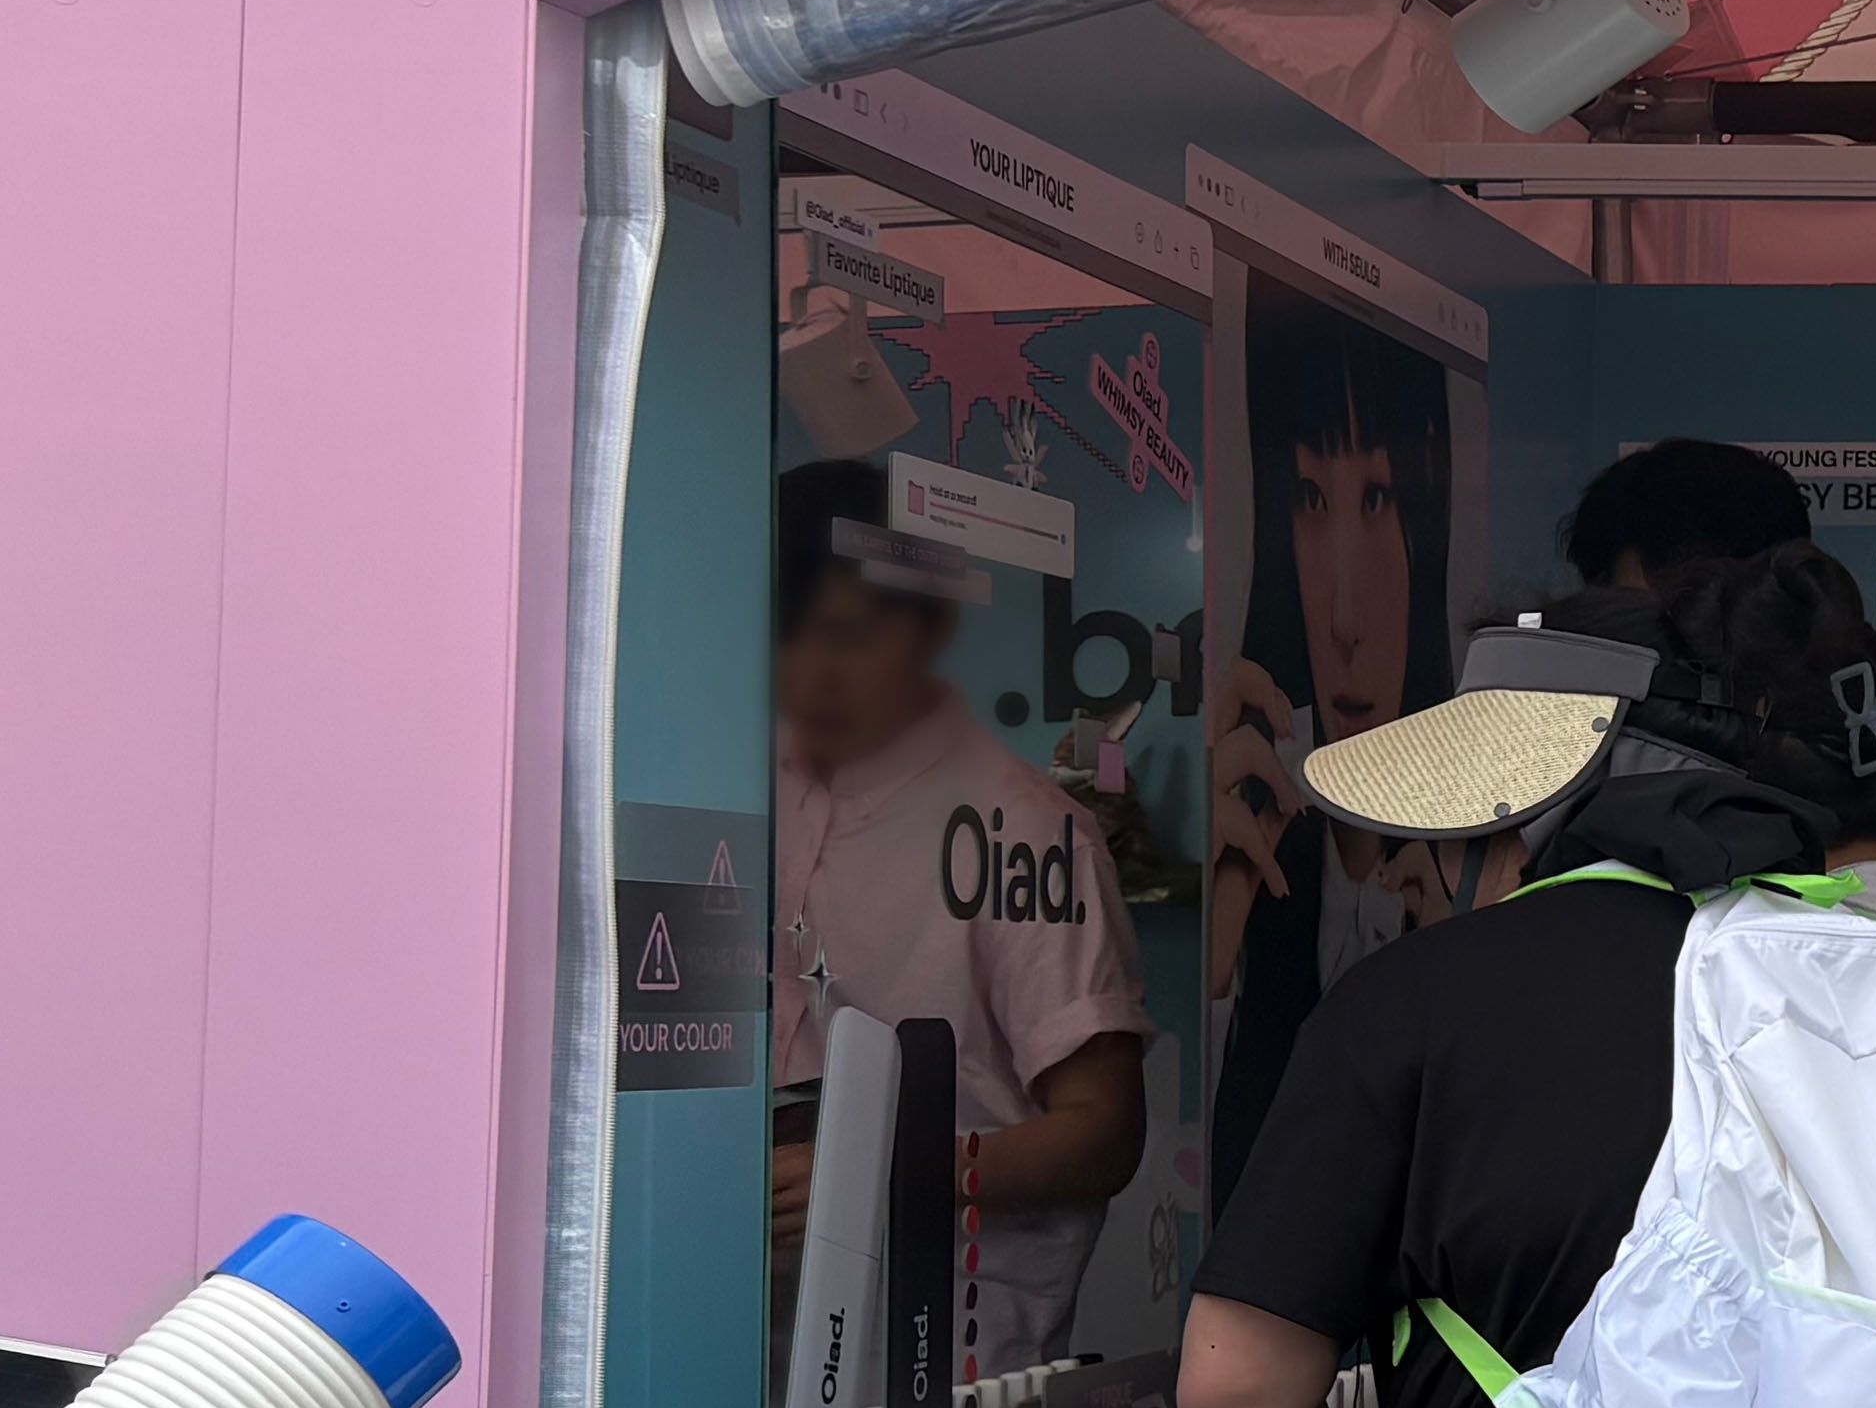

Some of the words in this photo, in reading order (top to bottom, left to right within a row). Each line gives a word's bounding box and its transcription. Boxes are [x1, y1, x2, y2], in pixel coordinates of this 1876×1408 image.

[970, 138, 1011, 185] YOUR
[1012, 157, 1075, 212] LIPTIQUE
[826, 243, 881, 285] Favorite
[882, 268, 935, 306] Liptique
[1322, 236, 1348, 271] WITH
[1097, 366, 1147, 436] WHIMSY
[1146, 424, 1191, 490] BEAUTY
[942, 805, 1086, 925] Oiad.
[620, 1023, 669, 1052] YOUR
[674, 1023, 732, 1051] COLOR
[820, 1306, 846, 1405] Oiad.
[913, 1304, 929, 1402] Oiad.
